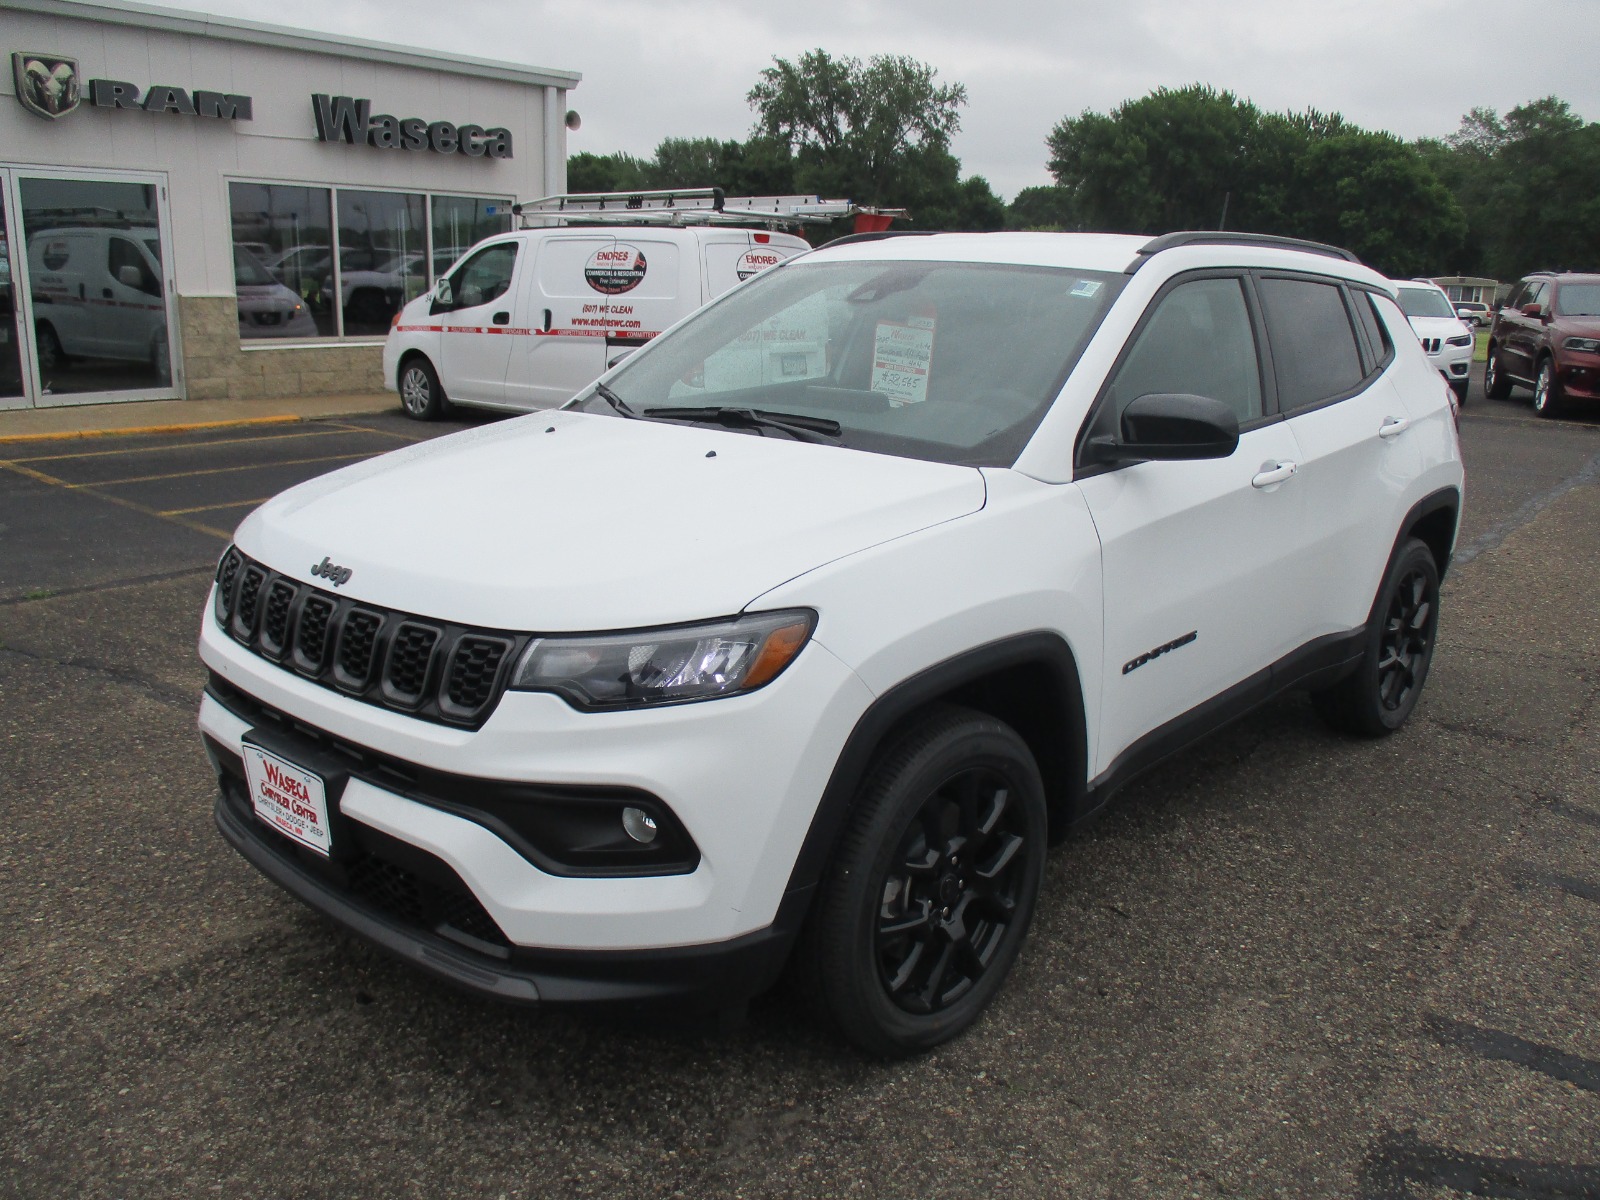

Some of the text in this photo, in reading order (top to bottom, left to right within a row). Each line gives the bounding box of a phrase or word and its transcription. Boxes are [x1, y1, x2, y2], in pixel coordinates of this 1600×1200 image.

[89, 78, 253, 121] RAM
[311, 93, 514, 159] Waseca
[597, 251, 628, 261] ENDRES
[571, 316, 641, 328] www.endreswc.com
[582, 304, 633, 314] (507) WE CLEAN
[626, 331, 655, 339] COMMITTED
[311, 556, 353, 587] Jeep
[263, 759, 311, 804] WASECA
[258, 795, 324, 837] CHRYSLER DODGE JEEP
[261, 782, 318, 825] CHRYSLER CENTER
